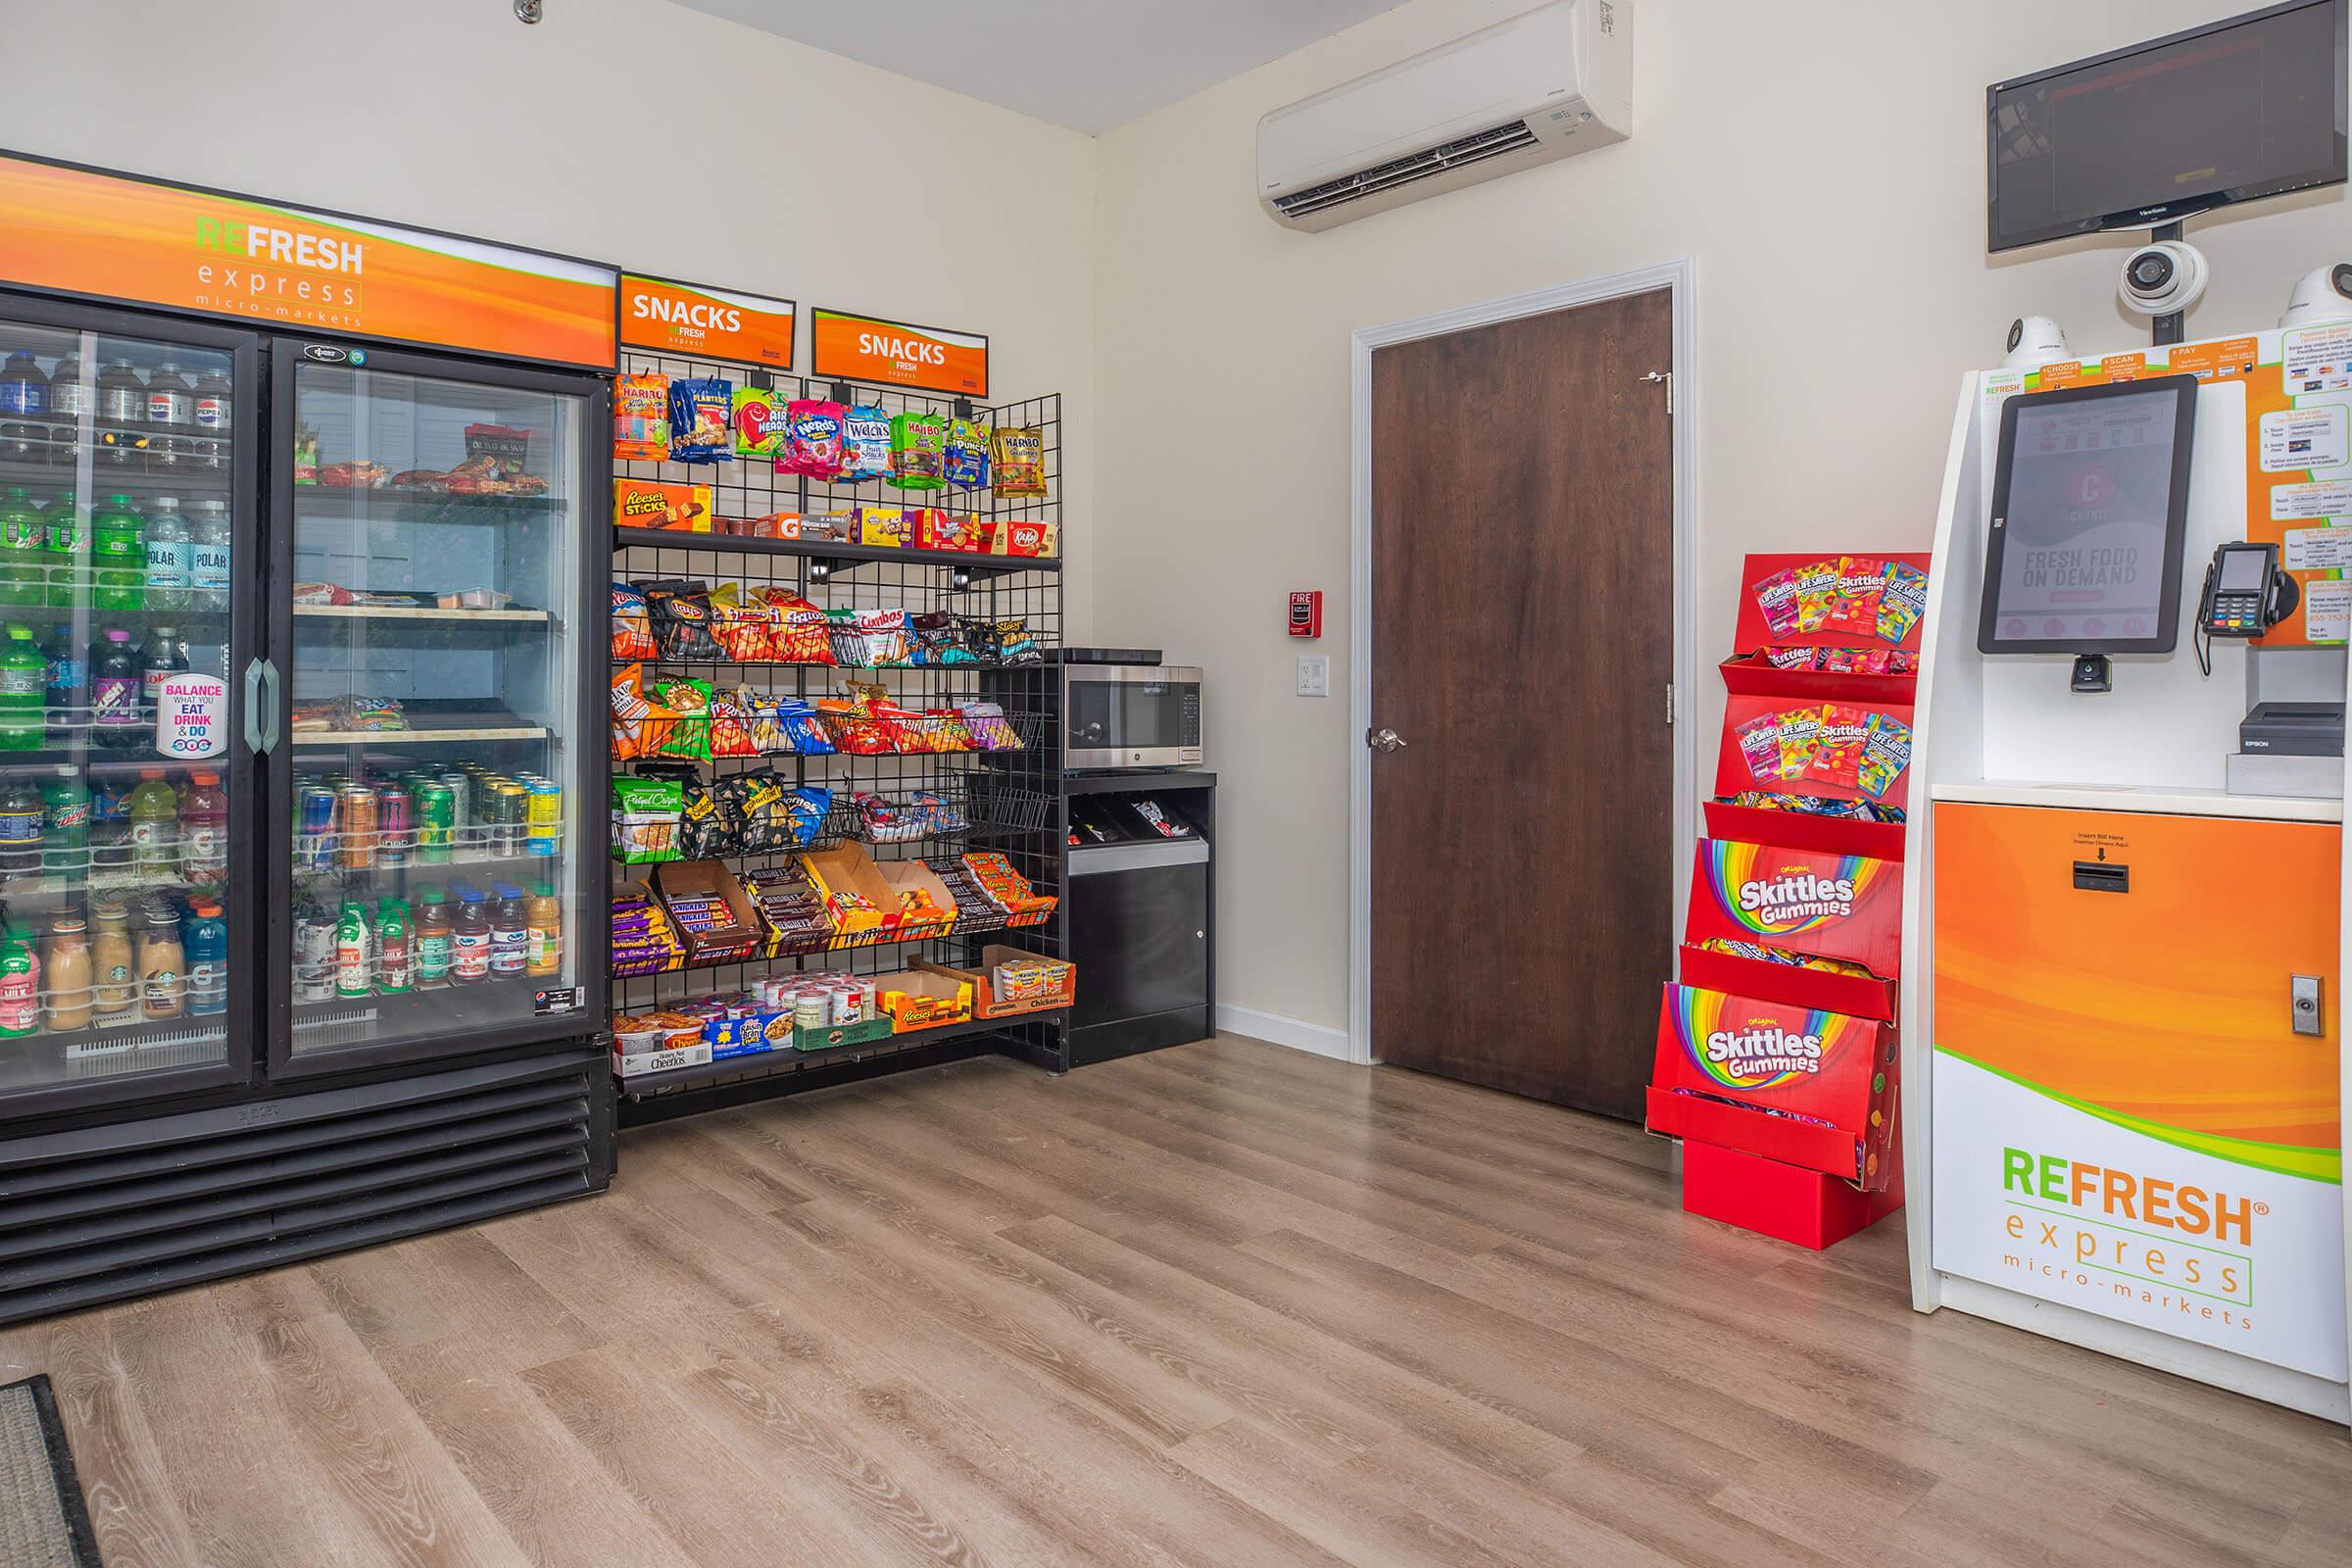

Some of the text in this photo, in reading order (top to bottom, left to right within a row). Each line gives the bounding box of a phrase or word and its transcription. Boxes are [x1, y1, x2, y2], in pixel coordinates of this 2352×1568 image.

[196, 215, 363, 275] REFRESH
[197, 265, 355, 306] express
[196, 294, 362, 327] micro-markets
[633, 294, 741, 332] SNACKS
[858, 333, 946, 365] SNACKS
[2109, 356, 2134, 365] SCAN
[2046, 364, 2080, 373] CHOOSE
[622, 387, 663, 400] HARIBO
[692, 394, 727, 405] PLANTERS
[768, 410, 787, 421] AIR
[758, 420, 787, 433] HEADS
[849, 421, 890, 438] Welch's
[907, 422, 941, 436] HARIBO
[1005, 437, 1040, 448] HARIBO
[626, 489, 664, 505] Reese's
[196, 553, 227, 568] POLAR
[2024, 547, 2138, 570] FRESH FOOD
[1838, 575, 1886, 589] Skittles
[2022, 566, 2137, 588] ON DEMAND
[1845, 585, 1885, 595] Gummies
[1291, 593, 1312, 603] FIRE
[860, 610, 905, 629] Combos
[166, 684, 222, 697] BALANCE
[172, 695, 215, 705] WHAT YOU
[181, 704, 205, 715] EAT
[173, 714, 212, 726] DRINK
[178, 726, 207, 737] & DO
[1820, 725, 1869, 738] Skittles
[1828, 735, 1867, 744] Gummies
[1739, 874, 1854, 910] Skittles
[672, 902, 708, 911] SNICKERS
[1760, 901, 1852, 925] Gummies
[1030, 998, 1059, 1008] Chicken
[902, 1008, 931, 1022] Reese's
[1706, 1027, 1823, 1062] Skittles
[651, 1055, 686, 1070] Cheerios
[1728, 1056, 1820, 1078] Gummies
[2005, 1214, 2238, 1295] express
[2003, 1253, 2252, 1331] micro-markets
